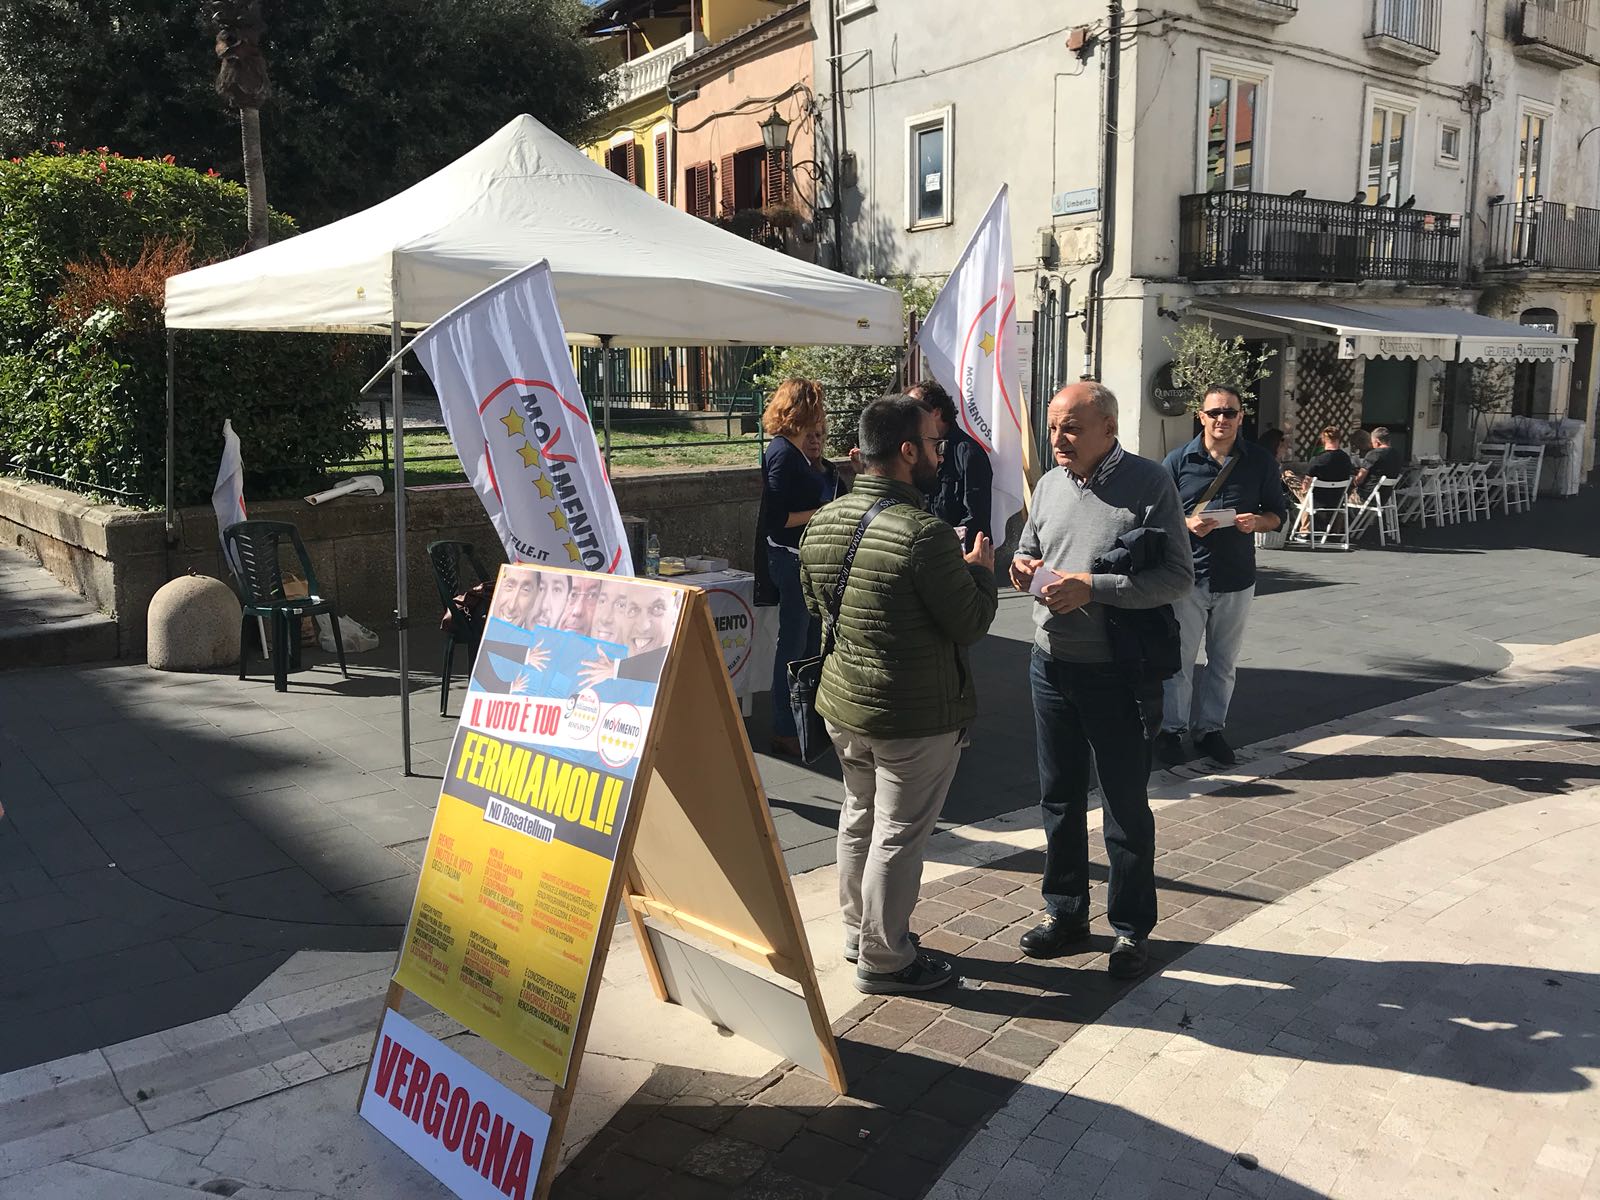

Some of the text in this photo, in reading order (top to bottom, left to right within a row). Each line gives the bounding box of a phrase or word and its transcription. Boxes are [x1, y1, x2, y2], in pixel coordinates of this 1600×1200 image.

[1067, 199, 1091, 208] Umberto
[521, 393, 605, 572] MOVIMENTO
[837, 523, 865, 597] ARMANI JEANS
[469, 698, 482, 728] IL
[485, 700, 519, 732] VOTO
[531, 704, 562, 736] TUO
[602, 717, 640, 738] MOVIMENTO
[455, 732, 624, 836] FERMIAMOLI!
[488, 800, 553, 843] NO Rosatellum
[525, 980, 550, 1000] MOVIMENTO
[553, 995, 568, 1010] STELLE
[373, 1033, 535, 1200] VERGOGNA
